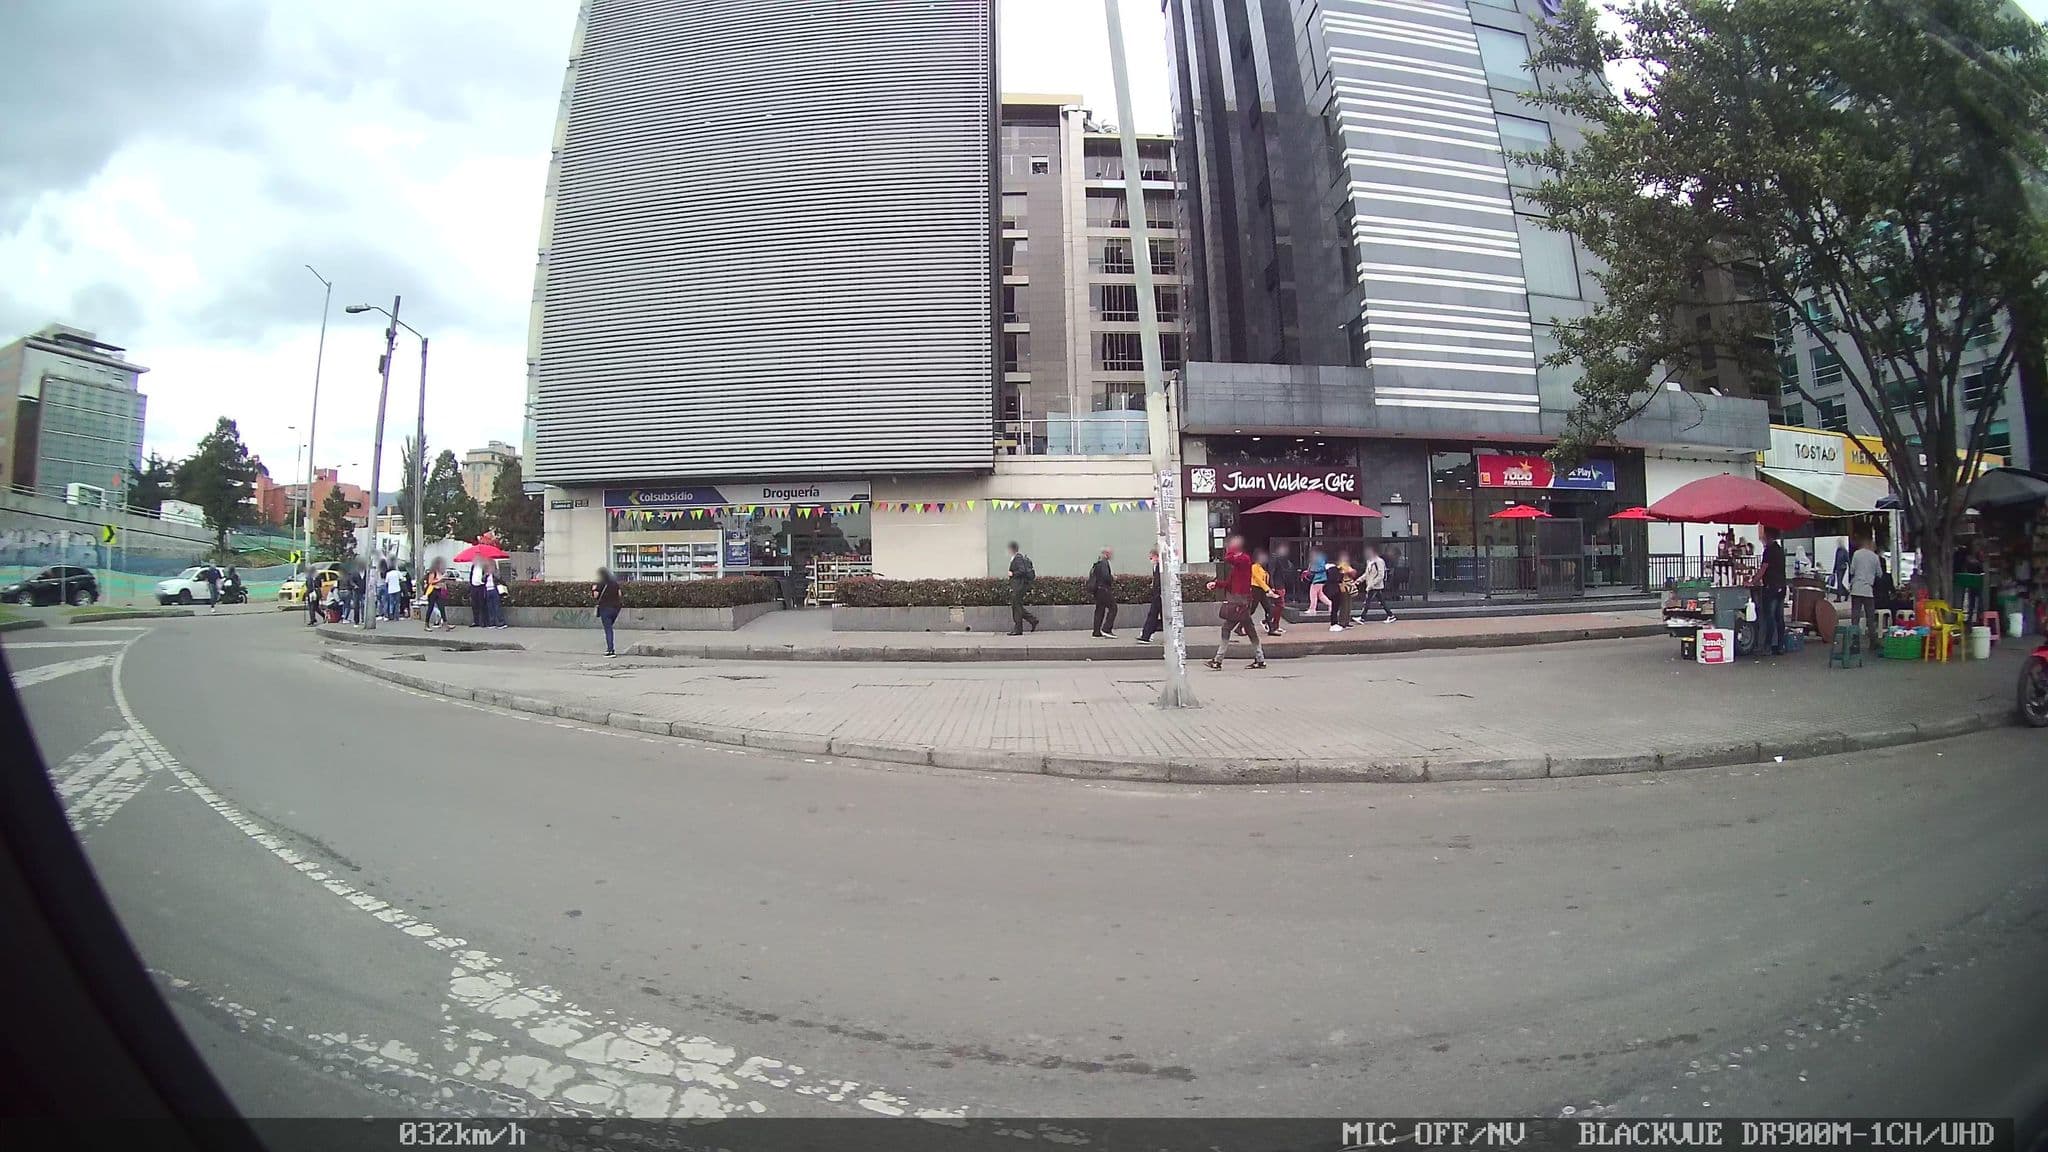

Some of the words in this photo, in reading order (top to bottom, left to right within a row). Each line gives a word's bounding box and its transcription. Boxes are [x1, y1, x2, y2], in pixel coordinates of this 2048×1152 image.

[1223, 471, 1266, 492] Juan
[1324, 473, 1355, 492] Café
[763, 485, 820, 501] Droguería
